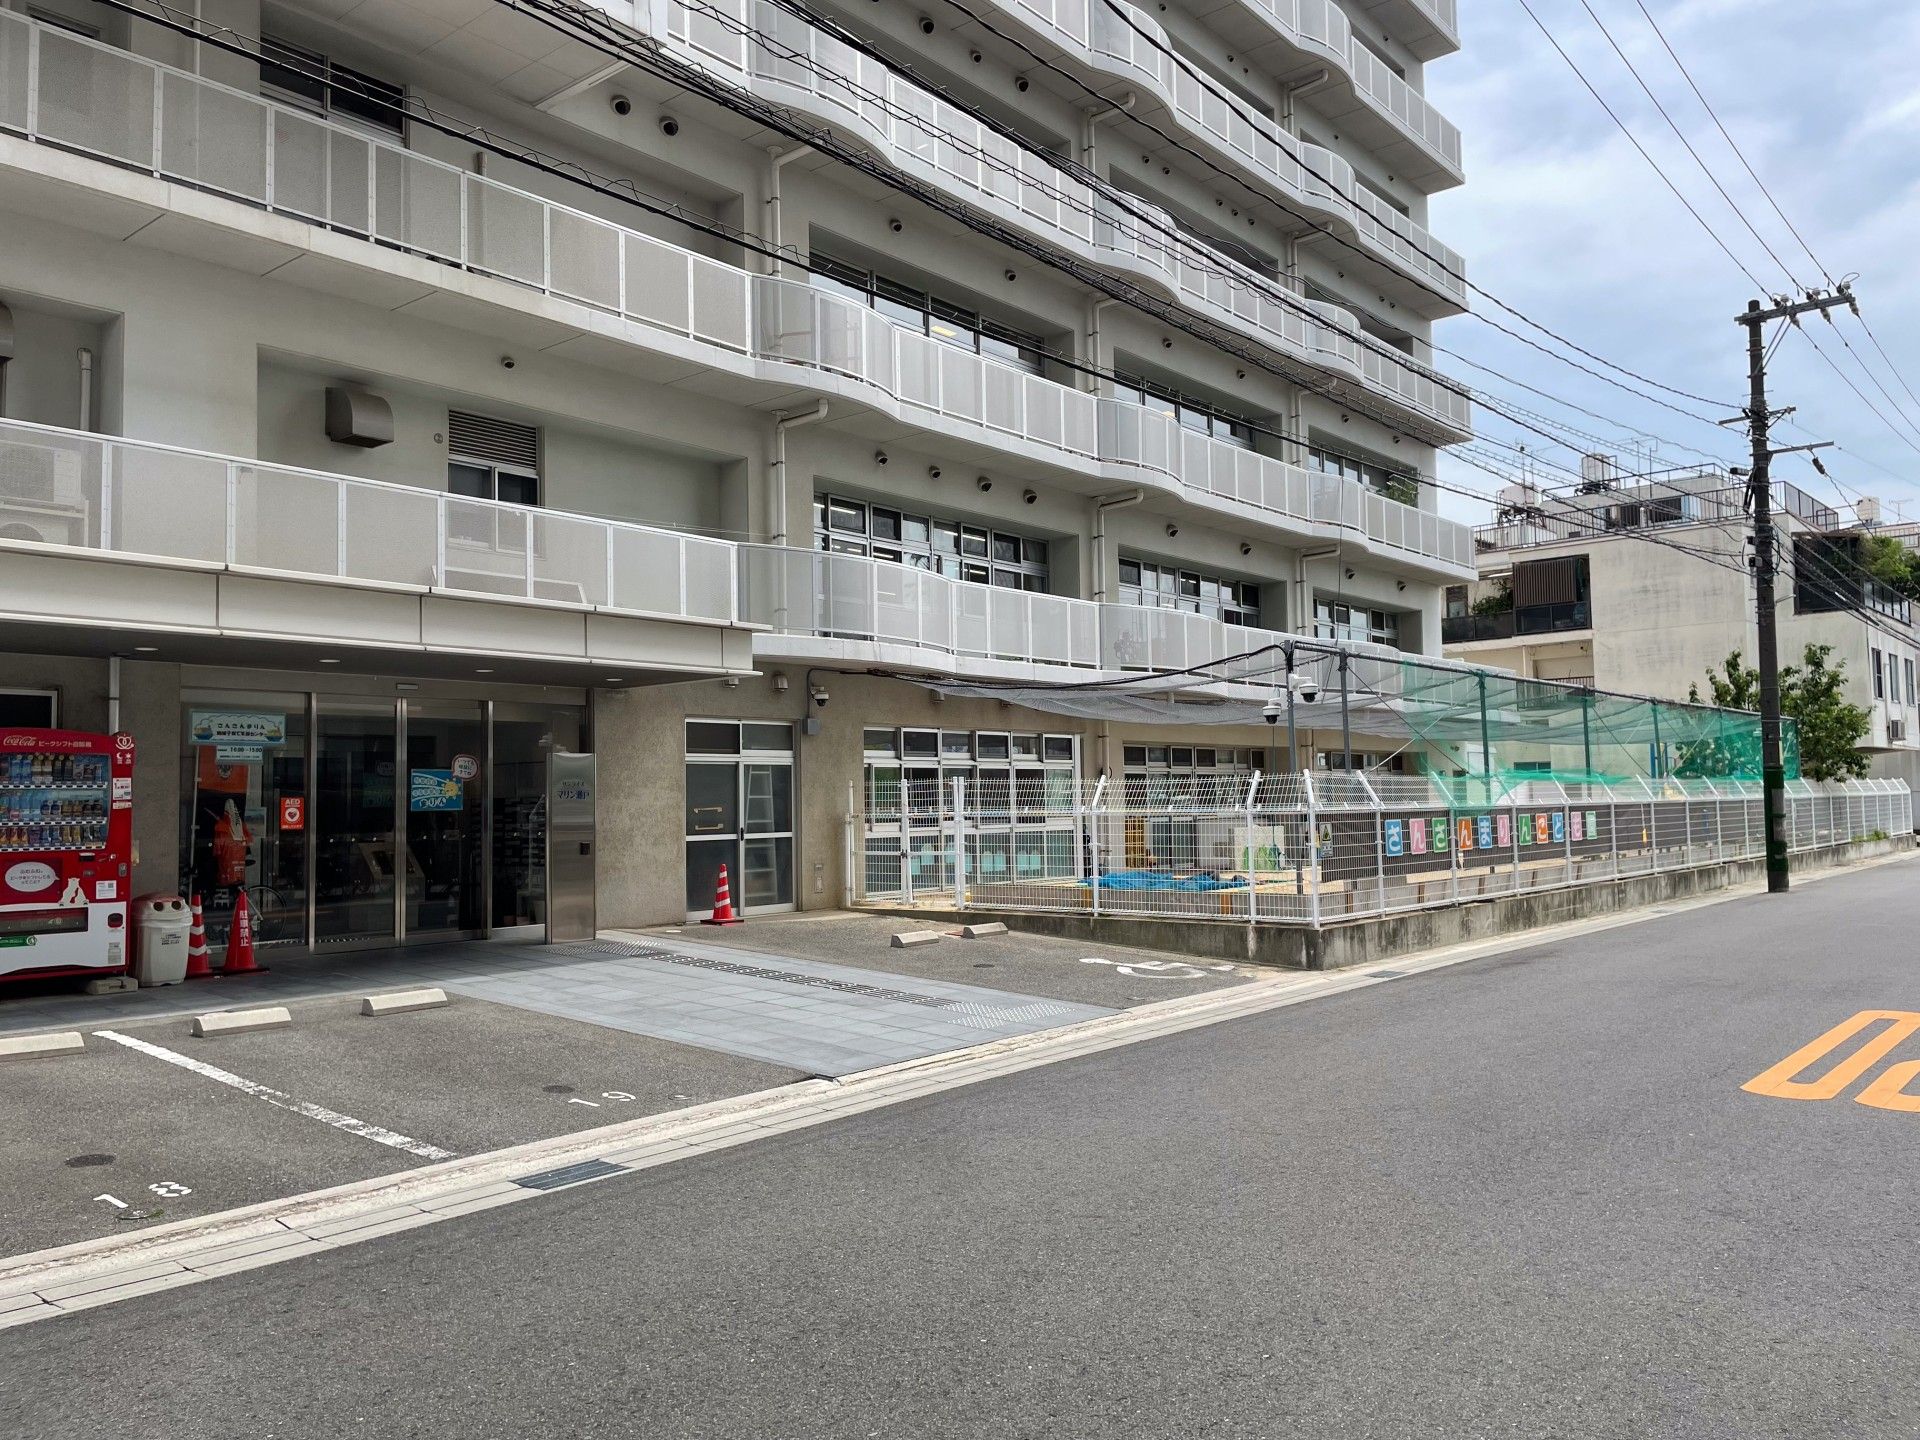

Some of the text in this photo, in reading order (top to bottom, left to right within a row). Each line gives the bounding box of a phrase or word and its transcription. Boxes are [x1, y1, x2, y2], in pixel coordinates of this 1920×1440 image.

[239, 910, 249, 947] 駐車禁止
[567, 1091, 636, 1107] 19
[93, 1181, 193, 1209] 18
